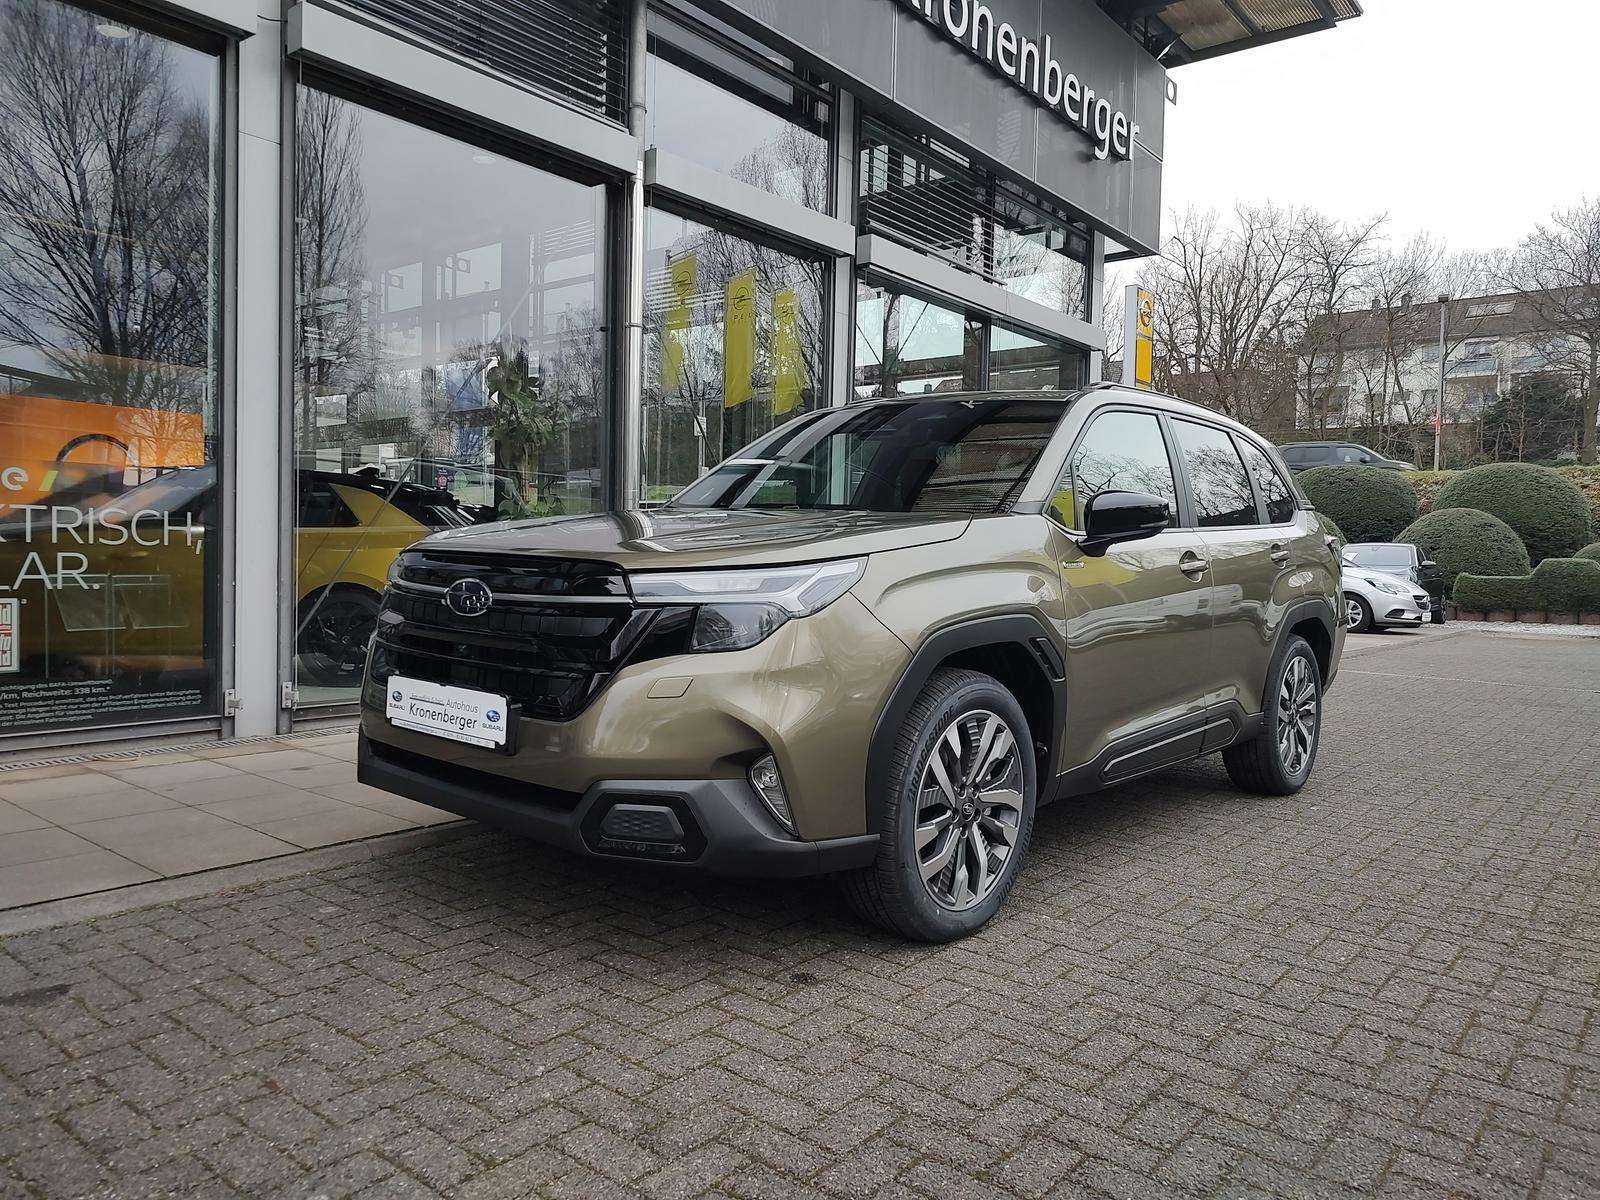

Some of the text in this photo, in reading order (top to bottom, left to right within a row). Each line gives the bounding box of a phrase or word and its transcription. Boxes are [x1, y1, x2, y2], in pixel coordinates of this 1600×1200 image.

[911, 0, 1139, 160] onenberger
[0, 504, 203, 555] TRISCH,
[22, 689, 73, 698] Reichweite:
[409, 702, 478, 730] Kronenberger
[446, 699, 479, 714] Autohaus
[482, 722, 504, 732] SUBARU
